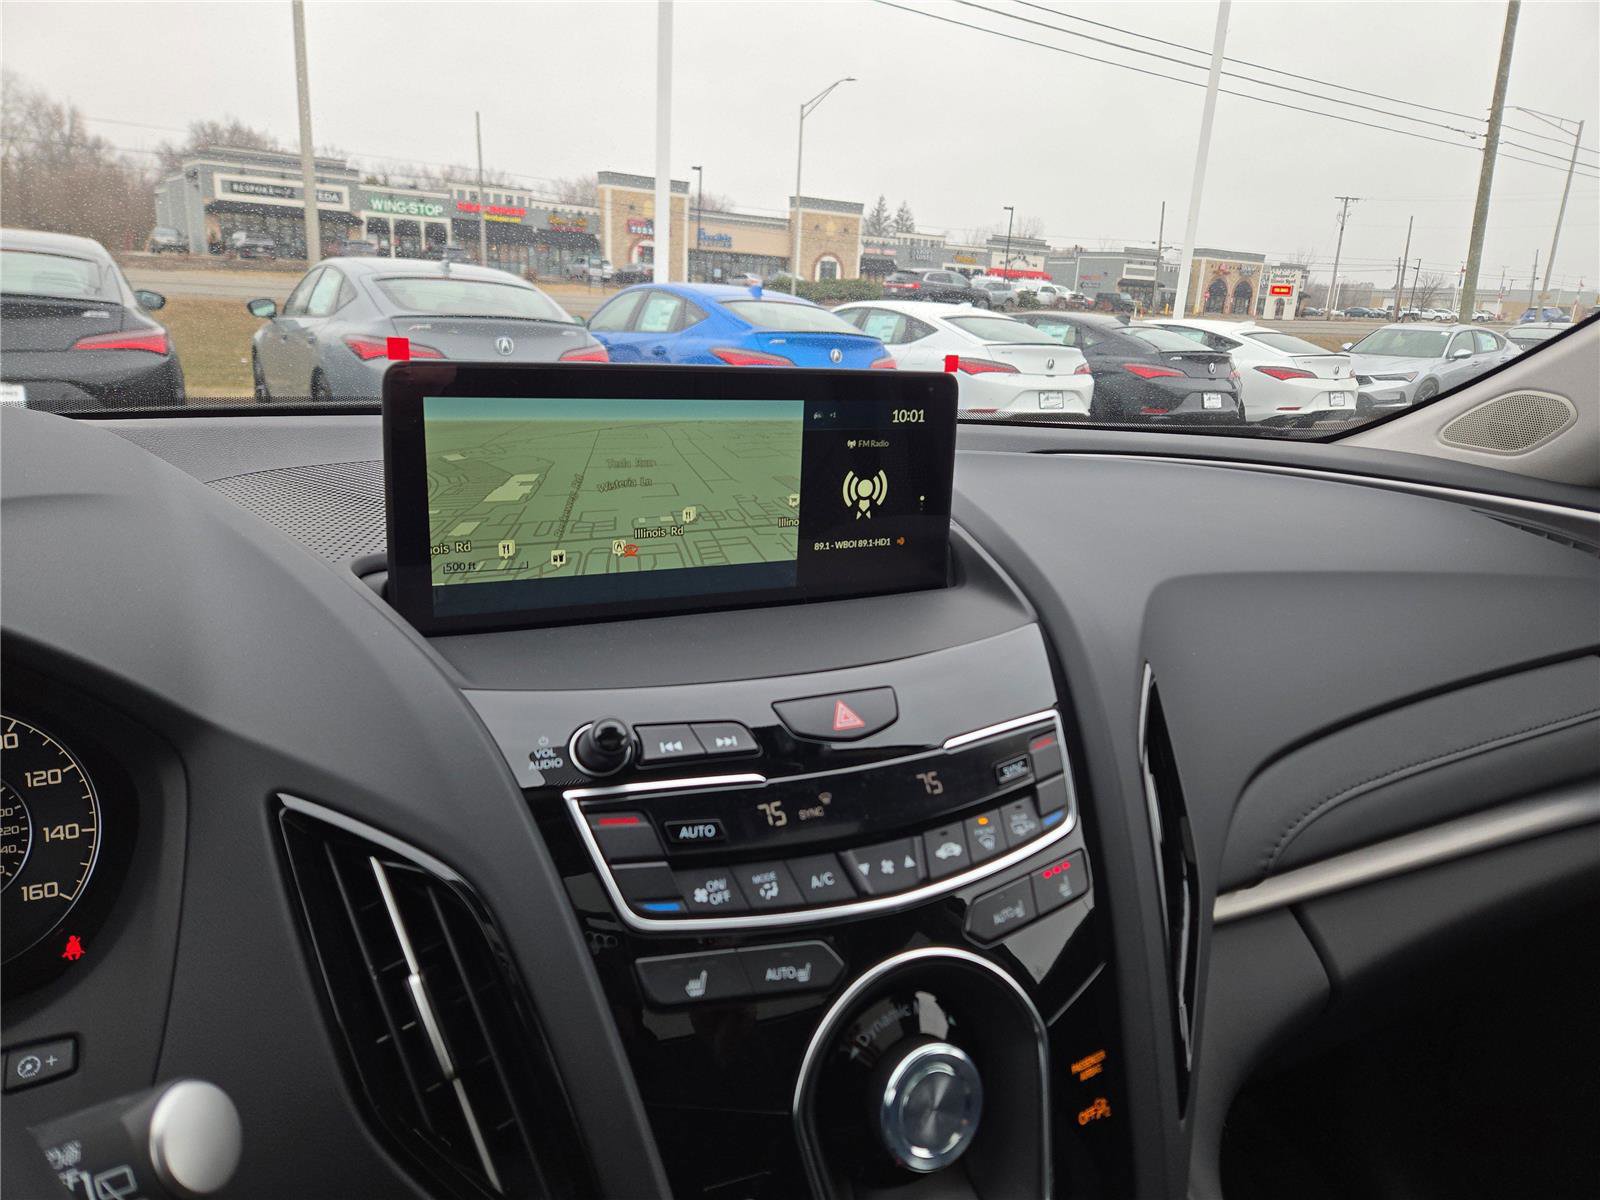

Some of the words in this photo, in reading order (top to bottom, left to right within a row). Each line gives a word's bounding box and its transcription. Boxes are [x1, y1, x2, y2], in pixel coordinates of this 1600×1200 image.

[891, 408, 926, 423] 10:01
[858, 439, 870, 448] FM
[870, 439, 890, 448] Radio
[777, 517, 800, 528] Illino
[633, 527, 666, 540] Illinois
[671, 525, 685, 537] Rd
[455, 541, 472, 553] Rd
[813, 541, 830, 551] 89.1
[834, 540, 858, 550] WBOI
[857, 538, 891, 548] 89.1-HD1
[445, 562, 466, 572] 500
[467, 562, 477, 571] ft
[533, 748, 557, 759] VOL
[528, 757, 564, 771] AUDIO
[24, 768, 62, 788] 120
[916, 771, 944, 795] 75
[757, 800, 788, 827] 75
[43, 823, 80, 842] 140
[679, 823, 717, 839] AUTO
[811, 871, 836, 890] A/C
[20, 881, 59, 902] 160
[765, 966, 797, 982] AUTO
